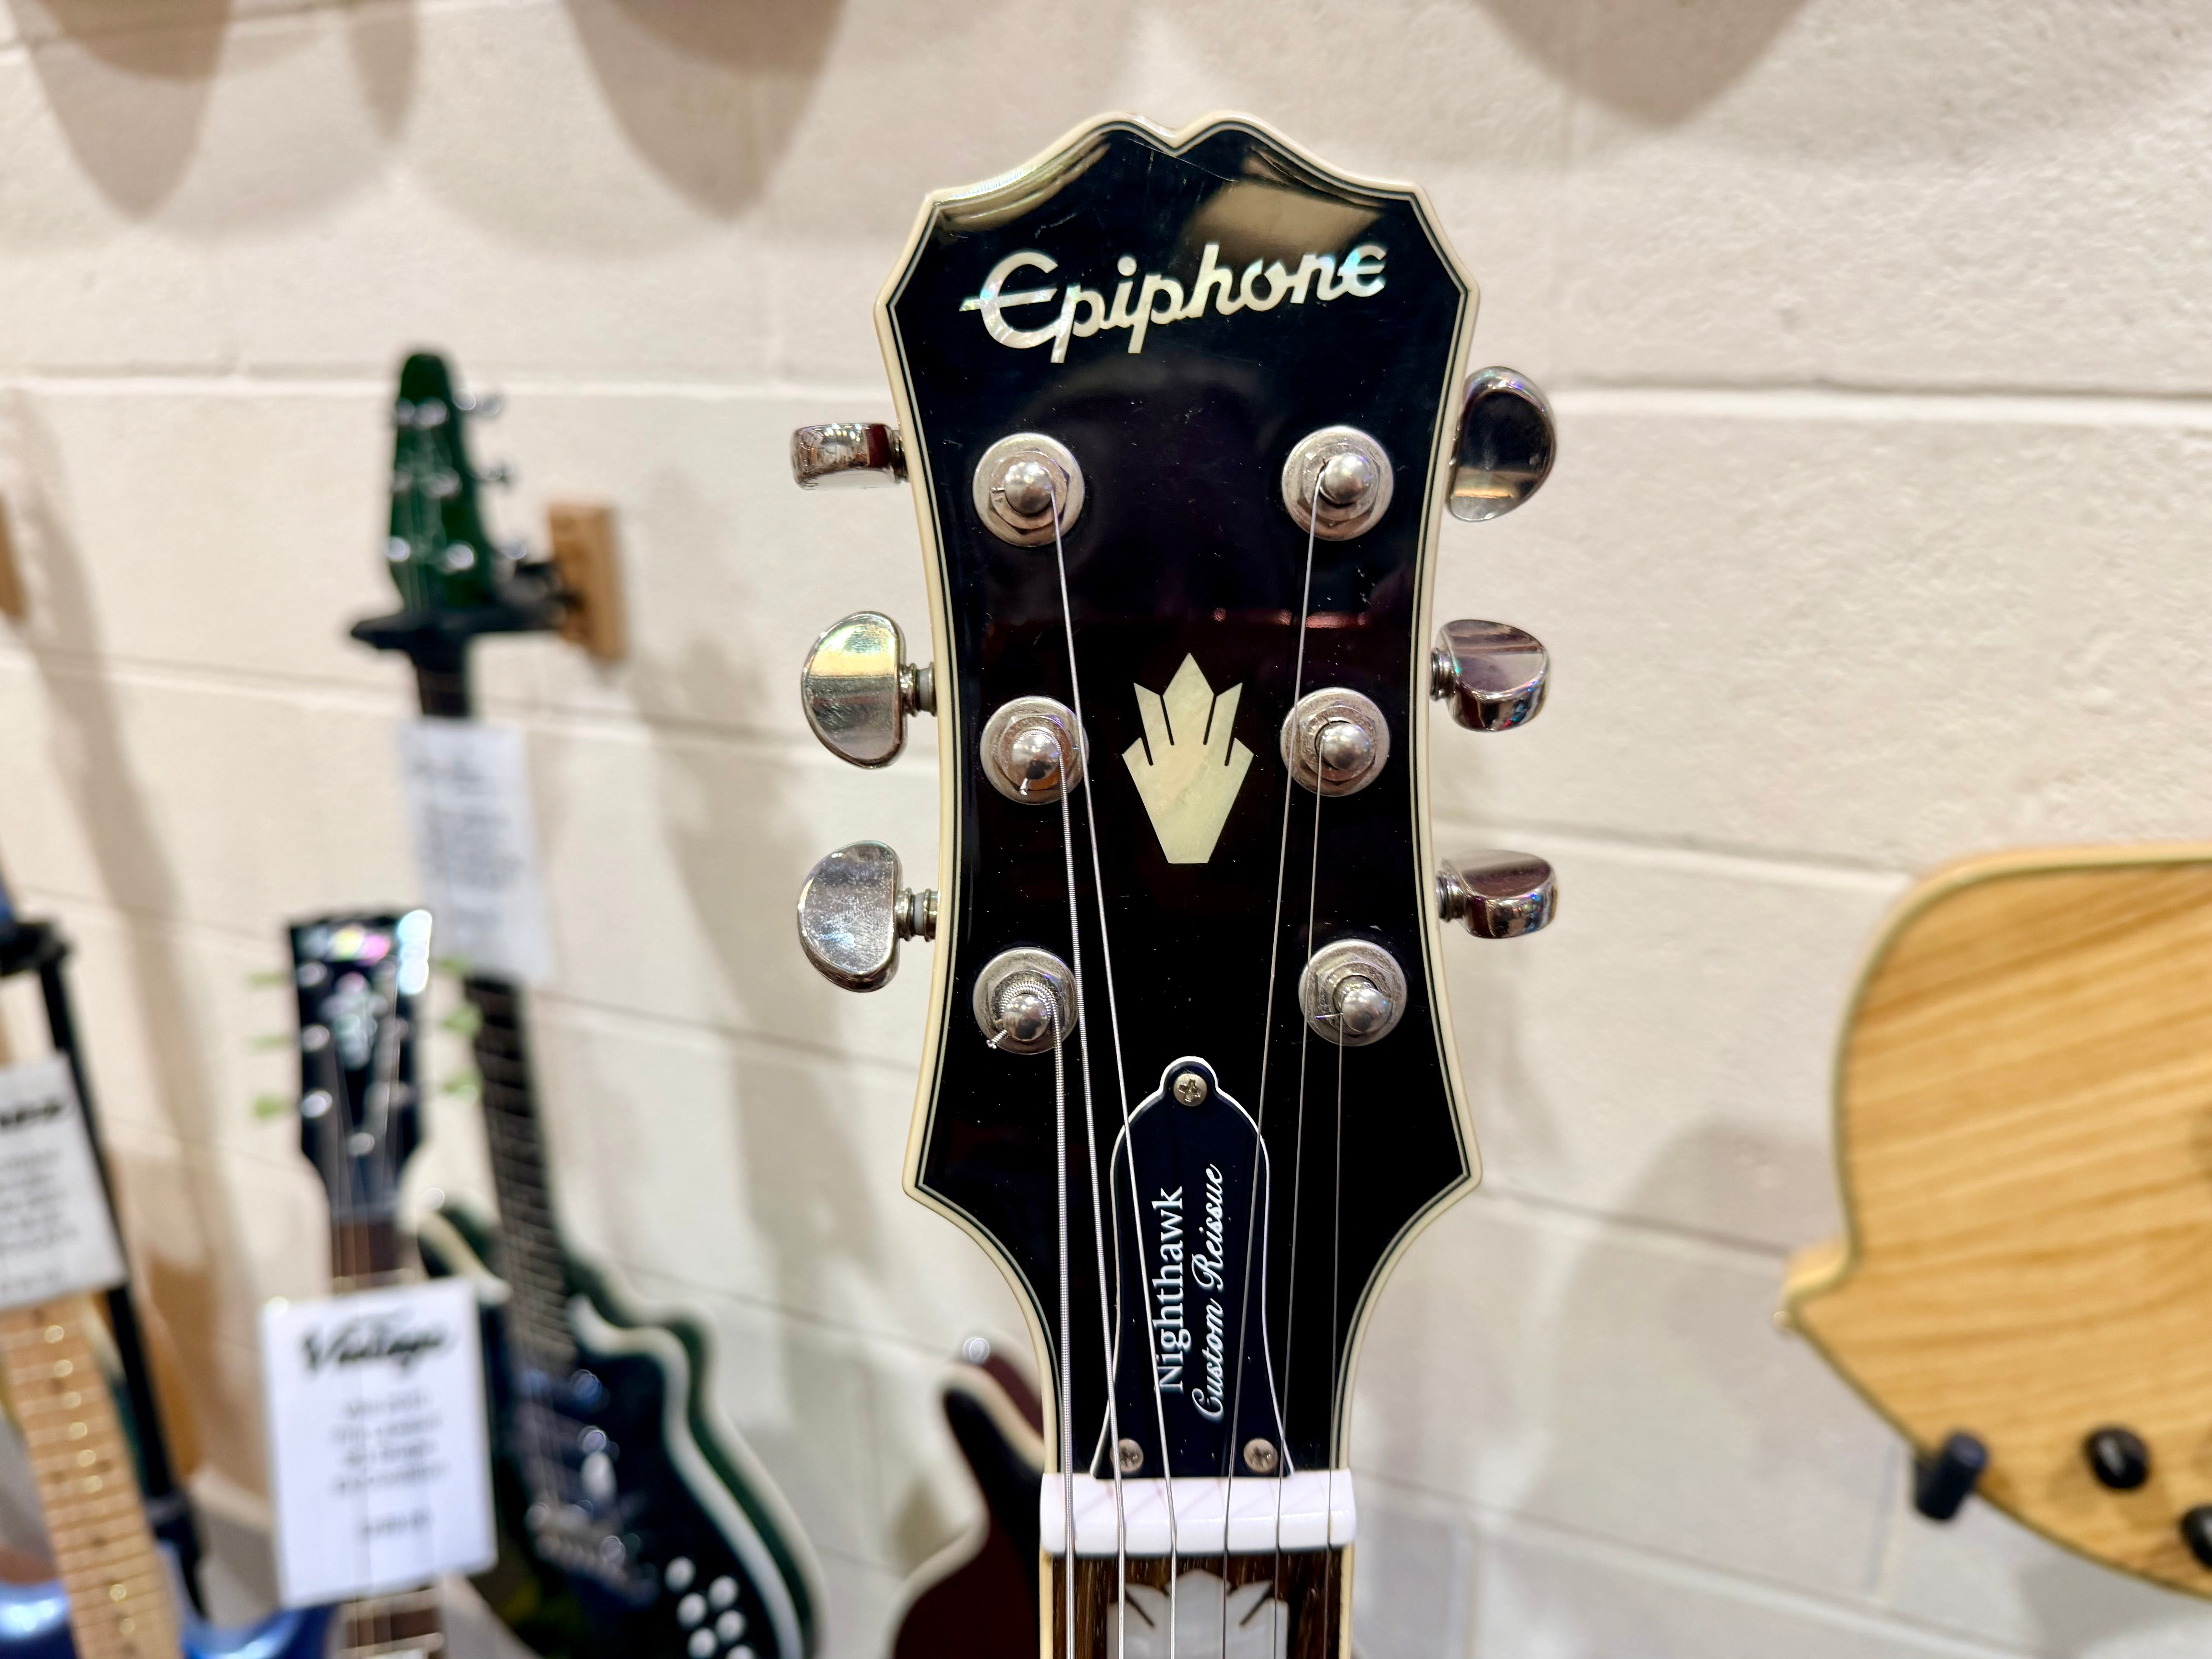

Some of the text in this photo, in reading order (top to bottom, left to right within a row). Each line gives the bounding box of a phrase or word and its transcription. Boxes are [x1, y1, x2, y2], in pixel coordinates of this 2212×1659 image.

[959, 242, 1386, 363] Epiphone
[1152, 1186, 1192, 1393] Nighthawk
[1192, 1163, 1224, 1420] Custom Reissue
